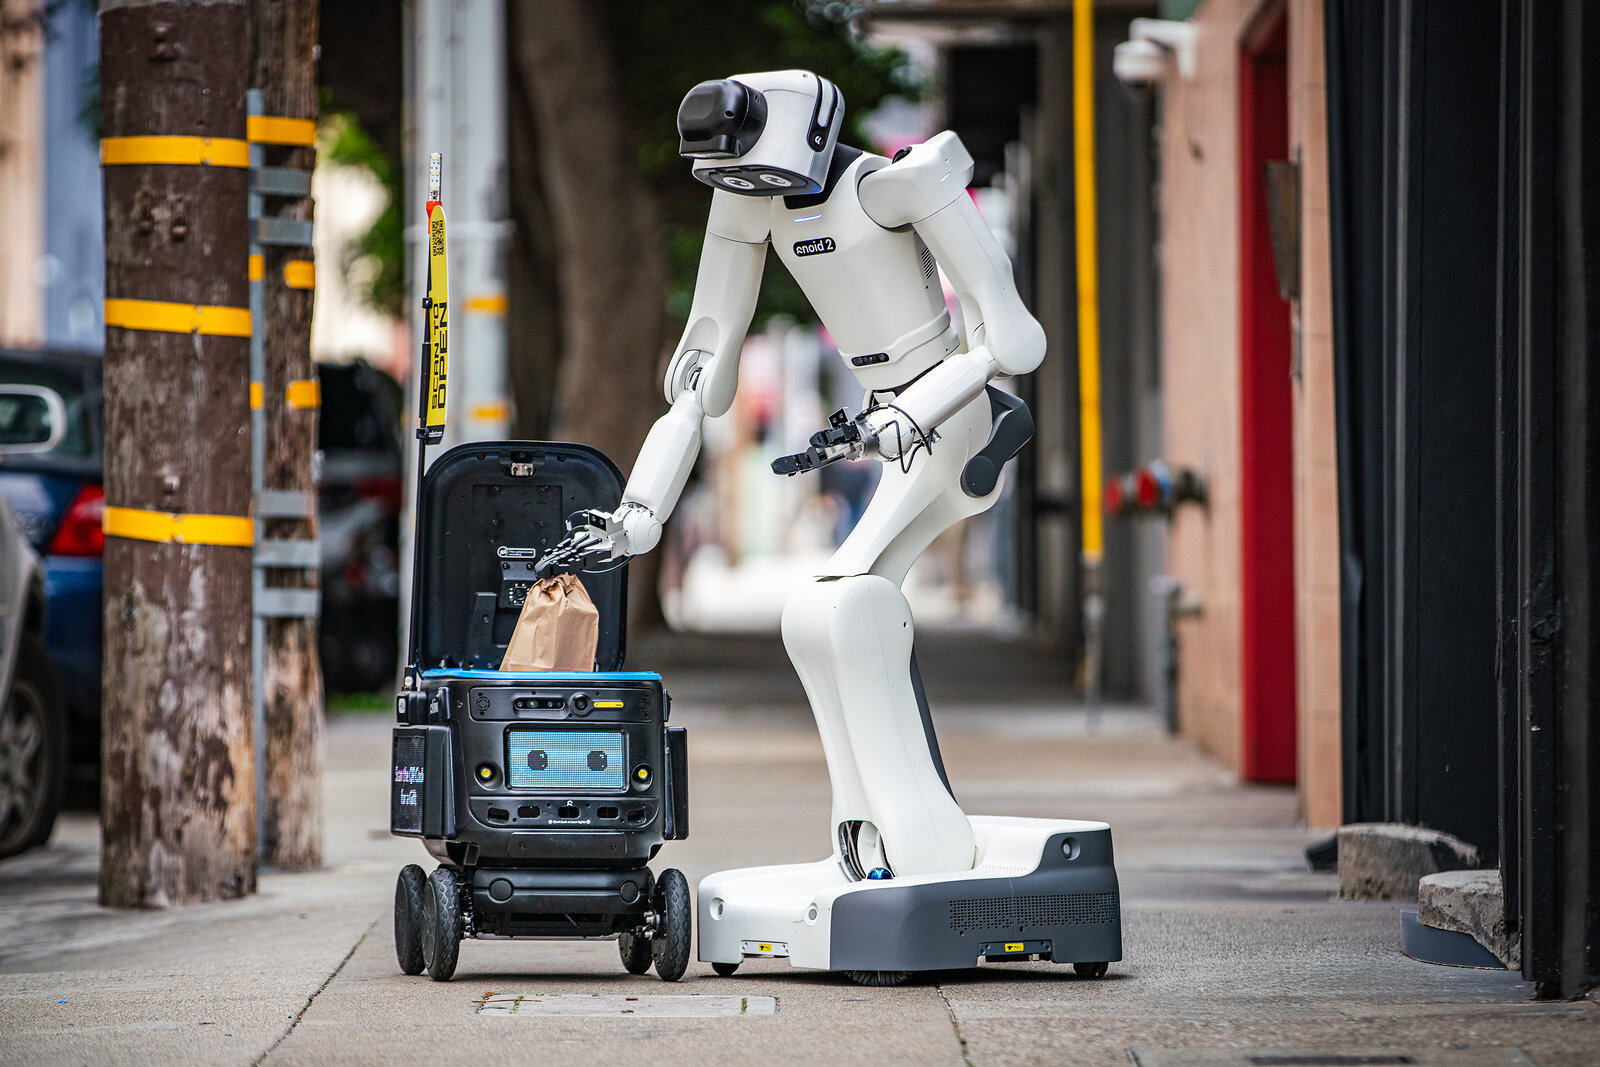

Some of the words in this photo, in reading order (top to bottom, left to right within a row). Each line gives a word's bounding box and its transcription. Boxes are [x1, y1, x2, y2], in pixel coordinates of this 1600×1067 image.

[825, 239, 834, 250] 2
[433, 303, 439, 336] TO
[438, 302, 447, 409] OPEN
